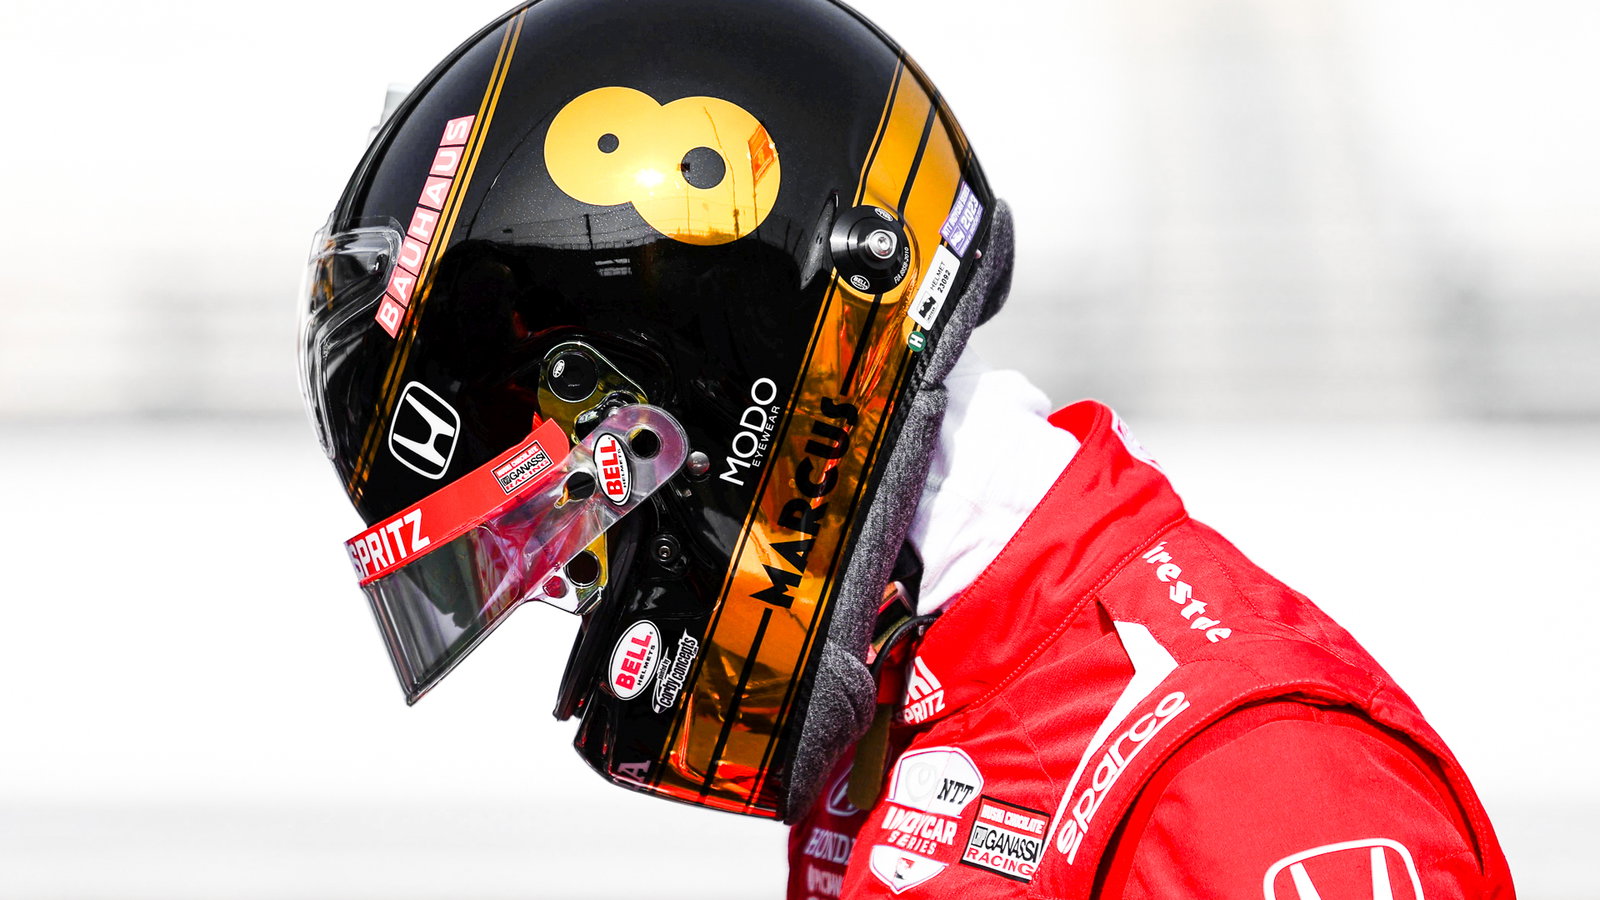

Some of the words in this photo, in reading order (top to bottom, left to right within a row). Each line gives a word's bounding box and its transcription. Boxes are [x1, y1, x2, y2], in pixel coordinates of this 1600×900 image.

[379, 118, 469, 330] BAUHAUS
[962, 193, 979, 230] 2023
[930, 261, 945, 291] HELMET
[938, 270, 951, 294] 23092
[719, 377, 777, 486] MODO
[752, 405, 780, 467] EYEWEAR
[506, 460, 549, 490] RACING
[509, 452, 545, 480] GANASSI
[600, 440, 624, 495] BELL
[617, 448, 627, 488] HELMETS
[749, 396, 858, 608] MARCUS
[347, 508, 430, 580] SPRITZ
[616, 634, 652, 690] BELL
[637, 645, 656, 686] HELMETS
[660, 677, 681, 706] corby
[671, 637, 696, 681] concepts
[902, 690, 946, 725] PRITZ
[937, 778, 974, 805] NTT
[1056, 691, 1191, 865] sparco
[881, 806, 958, 845] INDYCAR
[888, 830, 937, 855] SERIES
[966, 847, 1035, 876] RACING
[985, 829, 1040, 863] GANASSI
